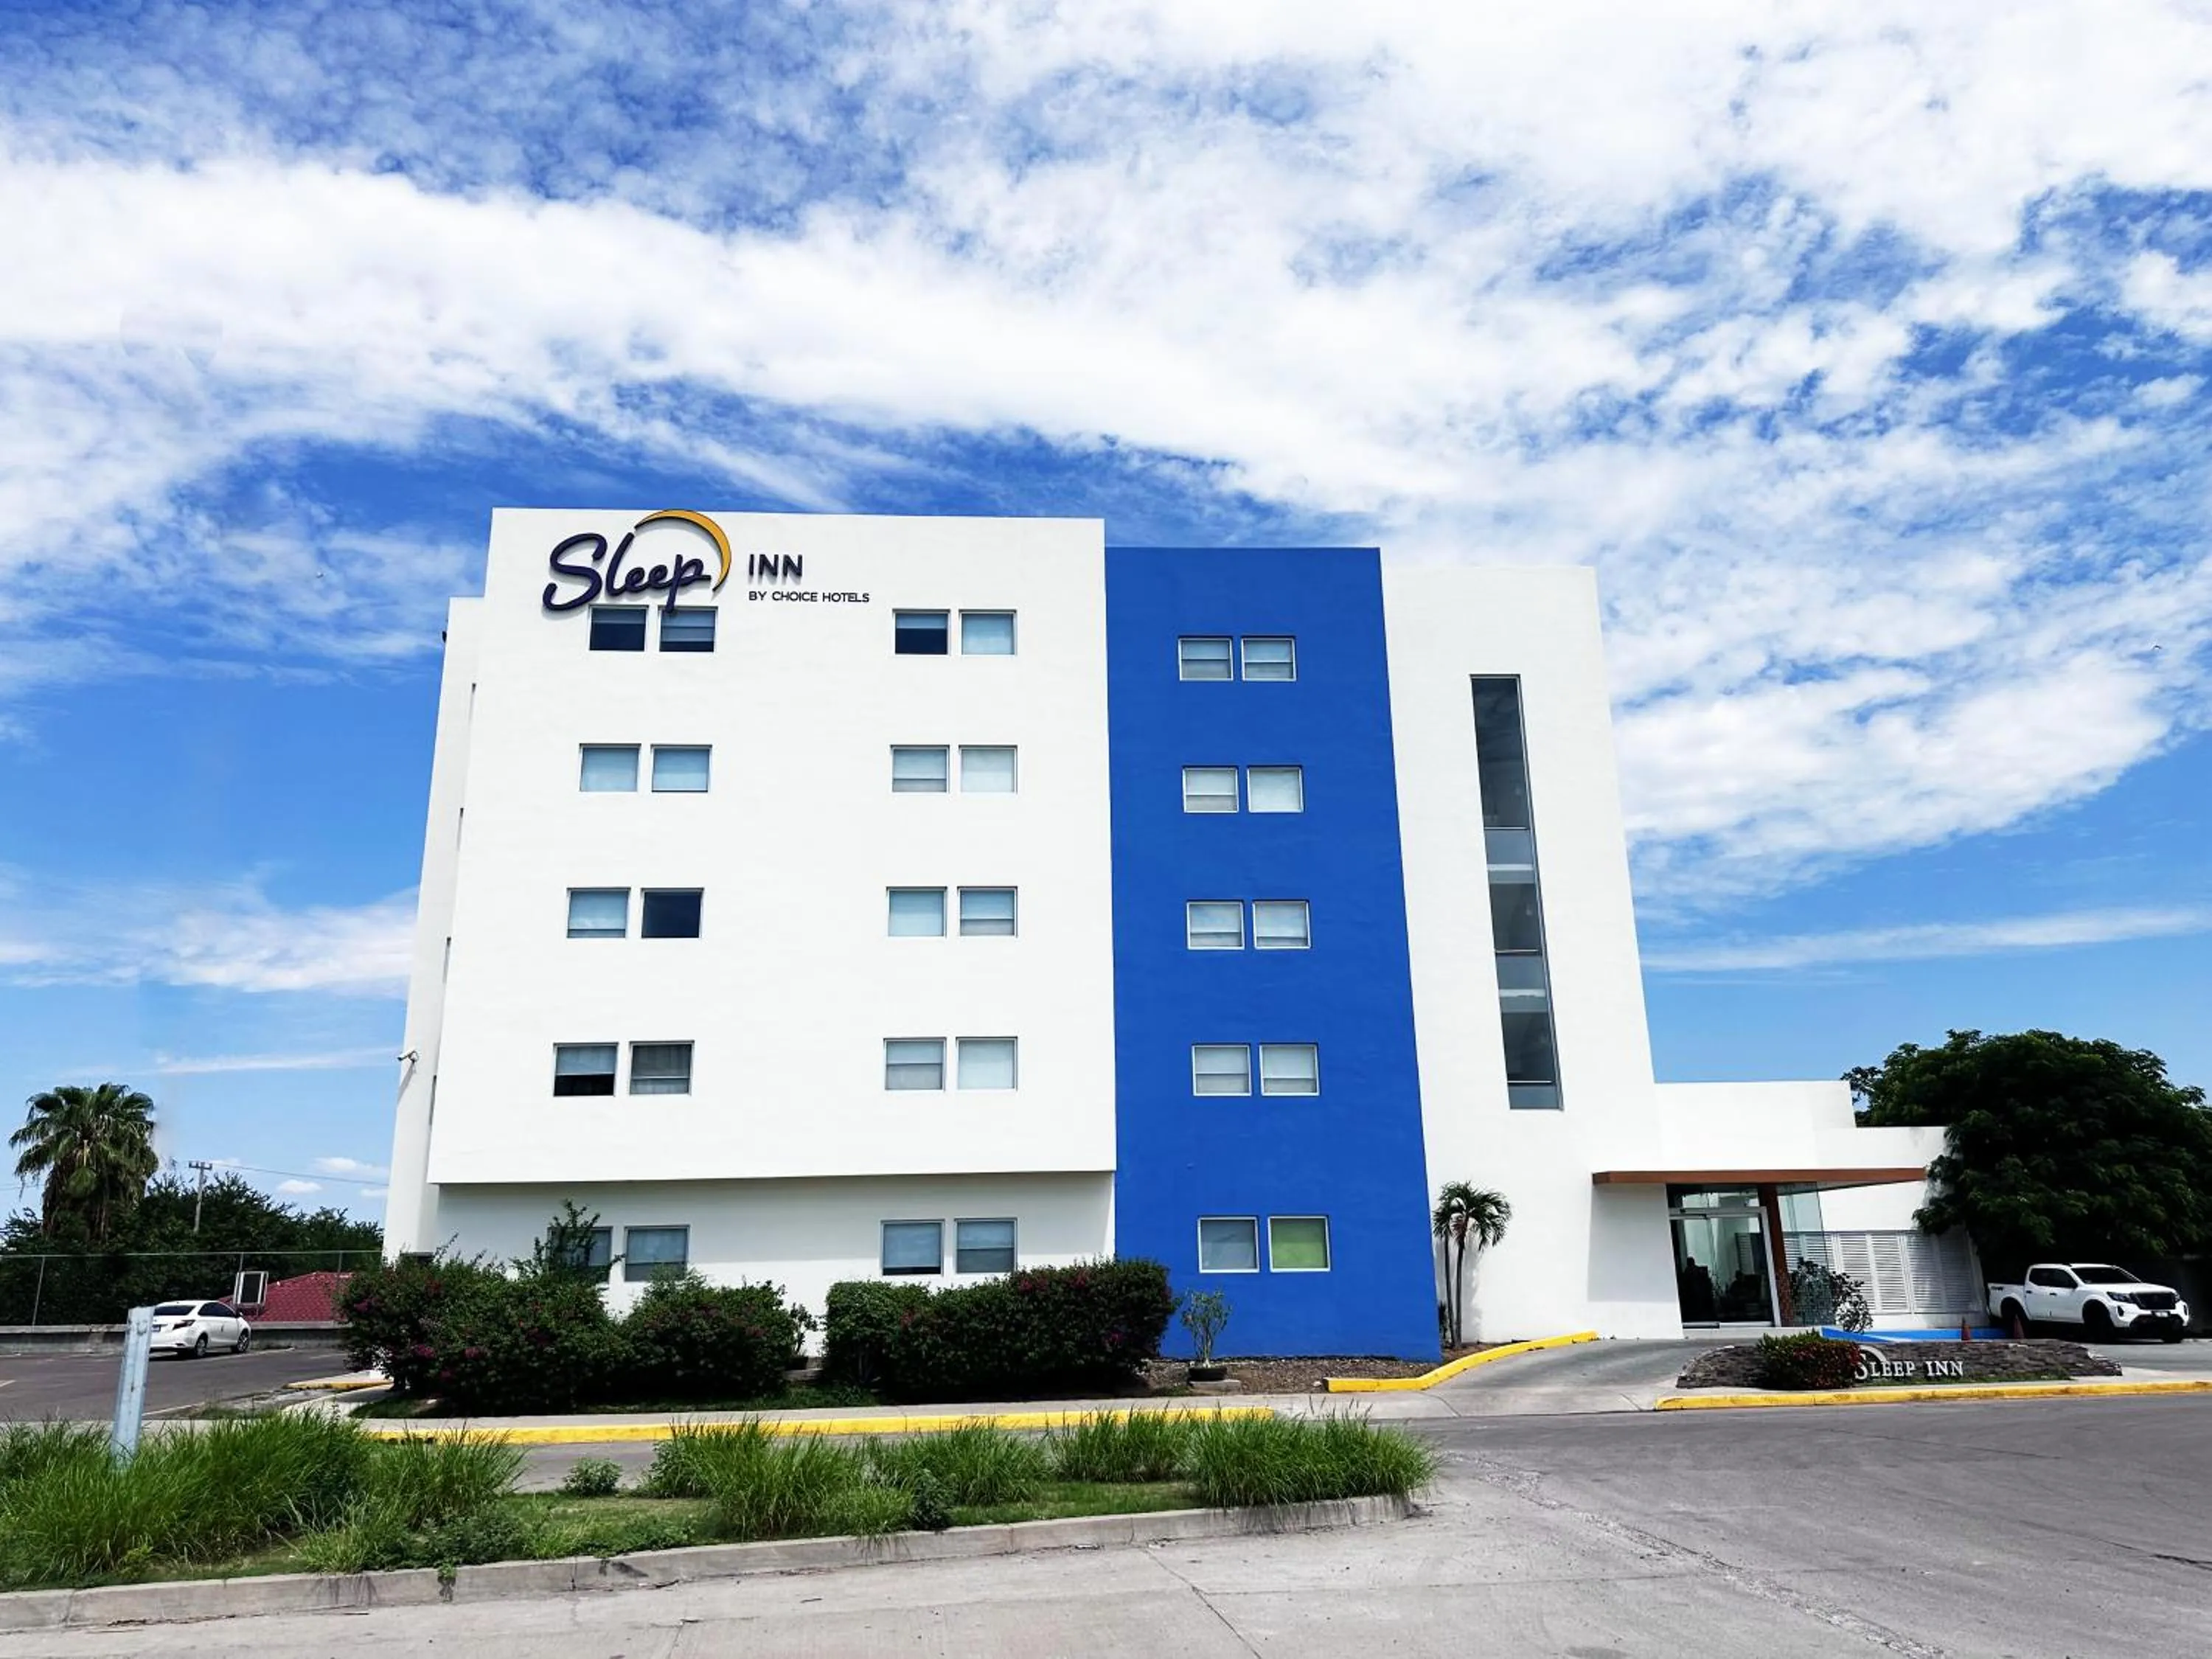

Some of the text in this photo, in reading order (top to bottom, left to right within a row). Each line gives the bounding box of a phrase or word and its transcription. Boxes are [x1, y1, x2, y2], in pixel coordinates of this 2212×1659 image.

[543, 532, 803, 613] Sleep INN
[748, 591, 869, 602] BY CHOICE HOTELS
[1854, 1354, 1964, 1380] SLEEP INN
